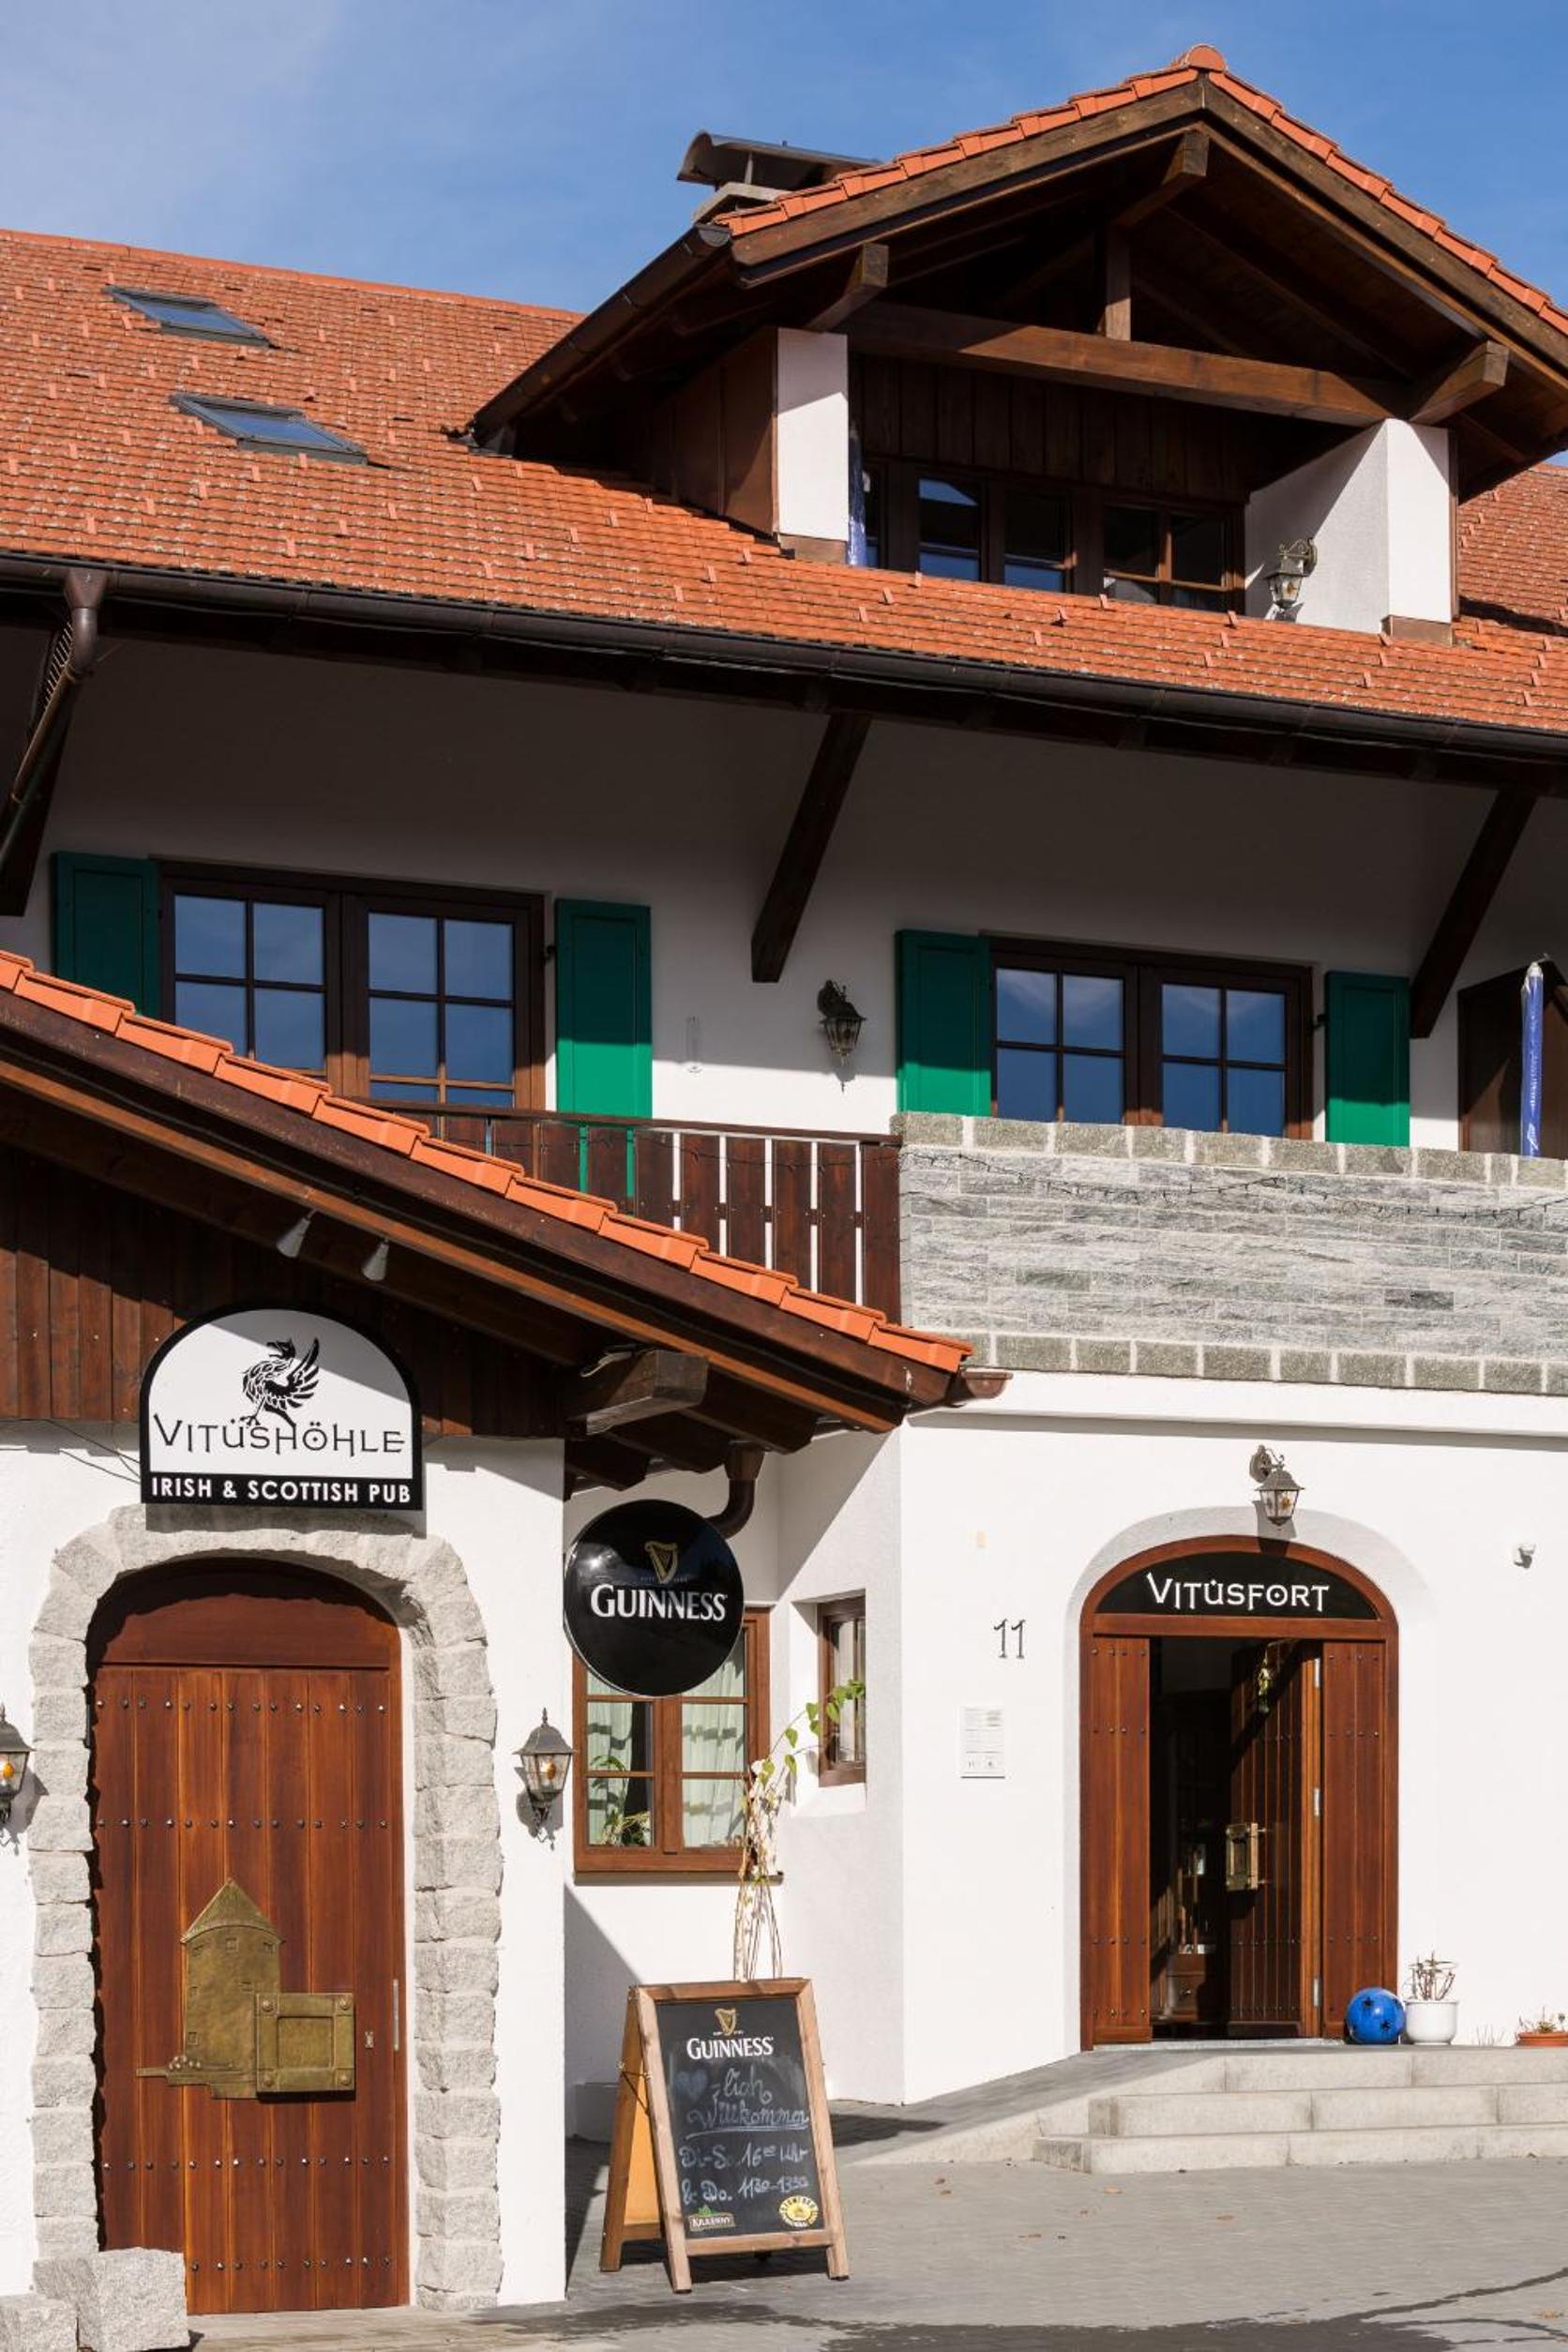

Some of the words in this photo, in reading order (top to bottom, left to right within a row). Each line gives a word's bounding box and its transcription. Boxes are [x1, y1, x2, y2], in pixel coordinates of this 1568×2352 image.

[151, 1477, 212, 1498] IRISH
[222, 1480, 237, 1499] &
[248, 1480, 358, 1502] SCOTTISH
[369, 1485, 411, 1503] PUB
[590, 1583, 727, 1621] GUINNESS
[993, 1618, 1027, 1659] 11
[686, 2036, 774, 2059] GUINNESS
[780, 2142, 809, 2164] Uhr
